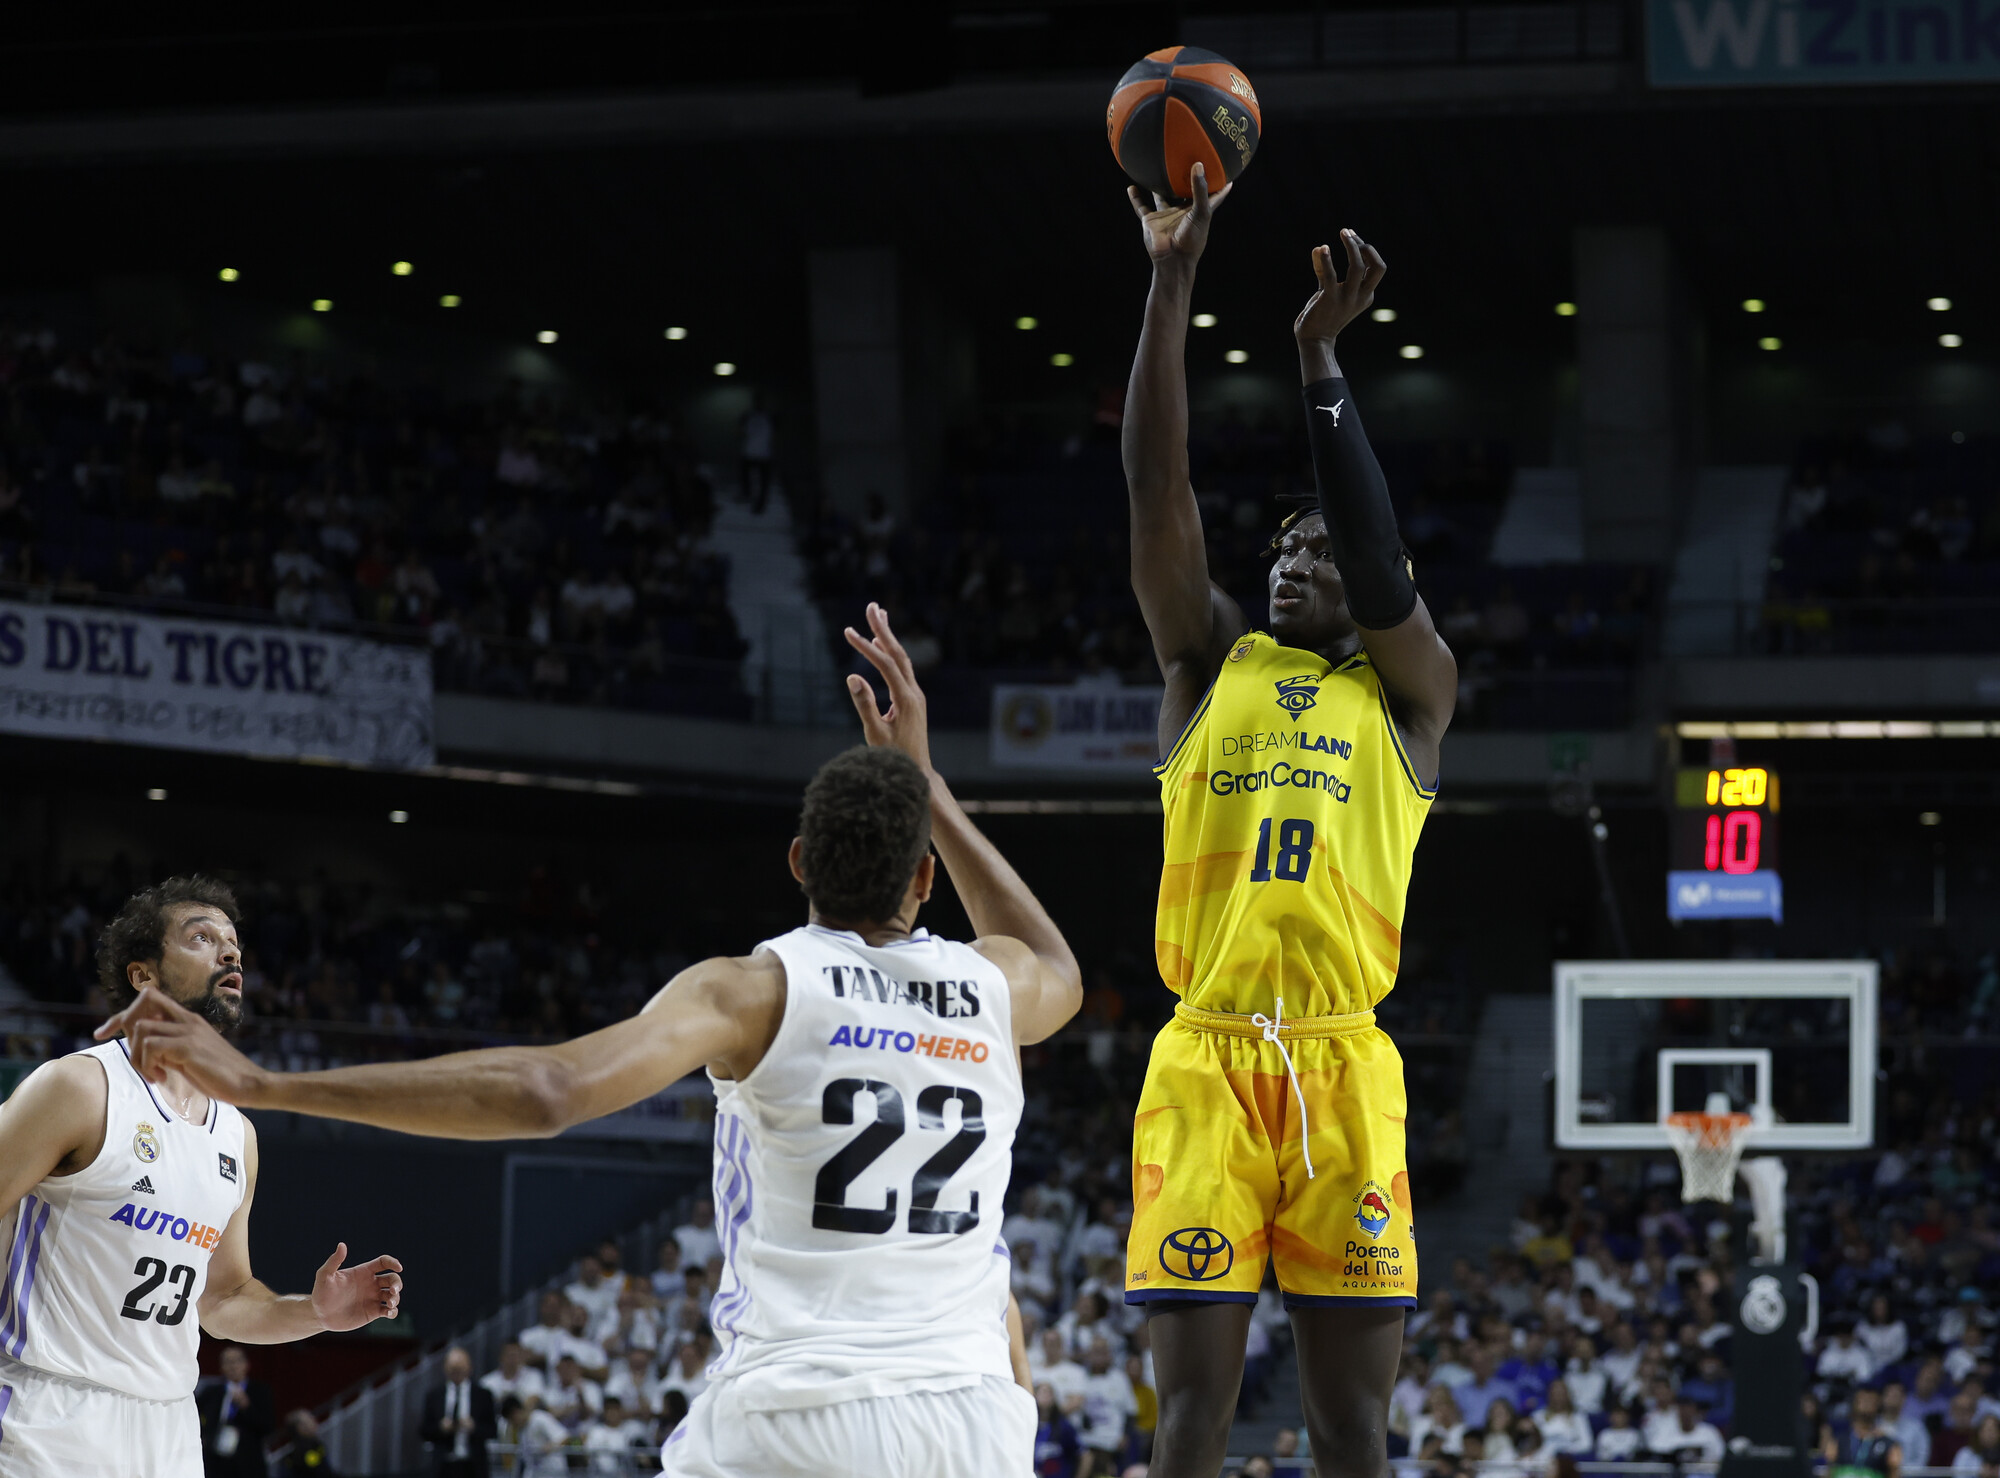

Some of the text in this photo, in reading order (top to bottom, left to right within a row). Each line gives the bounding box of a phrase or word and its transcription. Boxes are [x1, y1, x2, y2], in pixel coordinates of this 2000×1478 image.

[1673, 0, 2000, 69] WiZink
[43, 617, 150, 679] DEL
[165, 630, 331, 697] TIGRE
[1222, 731, 1353, 761] DREAMLAND
[1250, 818, 1315, 883] 18
[1704, 811, 1762, 875] 10
[829, 1025, 989, 1064] AUTOHERO
[812, 1078, 987, 1235] 22
[131, 1184, 155, 1195] adidas
[1343, 1261, 1403, 1276] del Mar
[1345, 1241, 1400, 1259] Poema
[120, 1256, 197, 1326] 23
[1342, 1281, 1405, 1289] AQUARIUM
